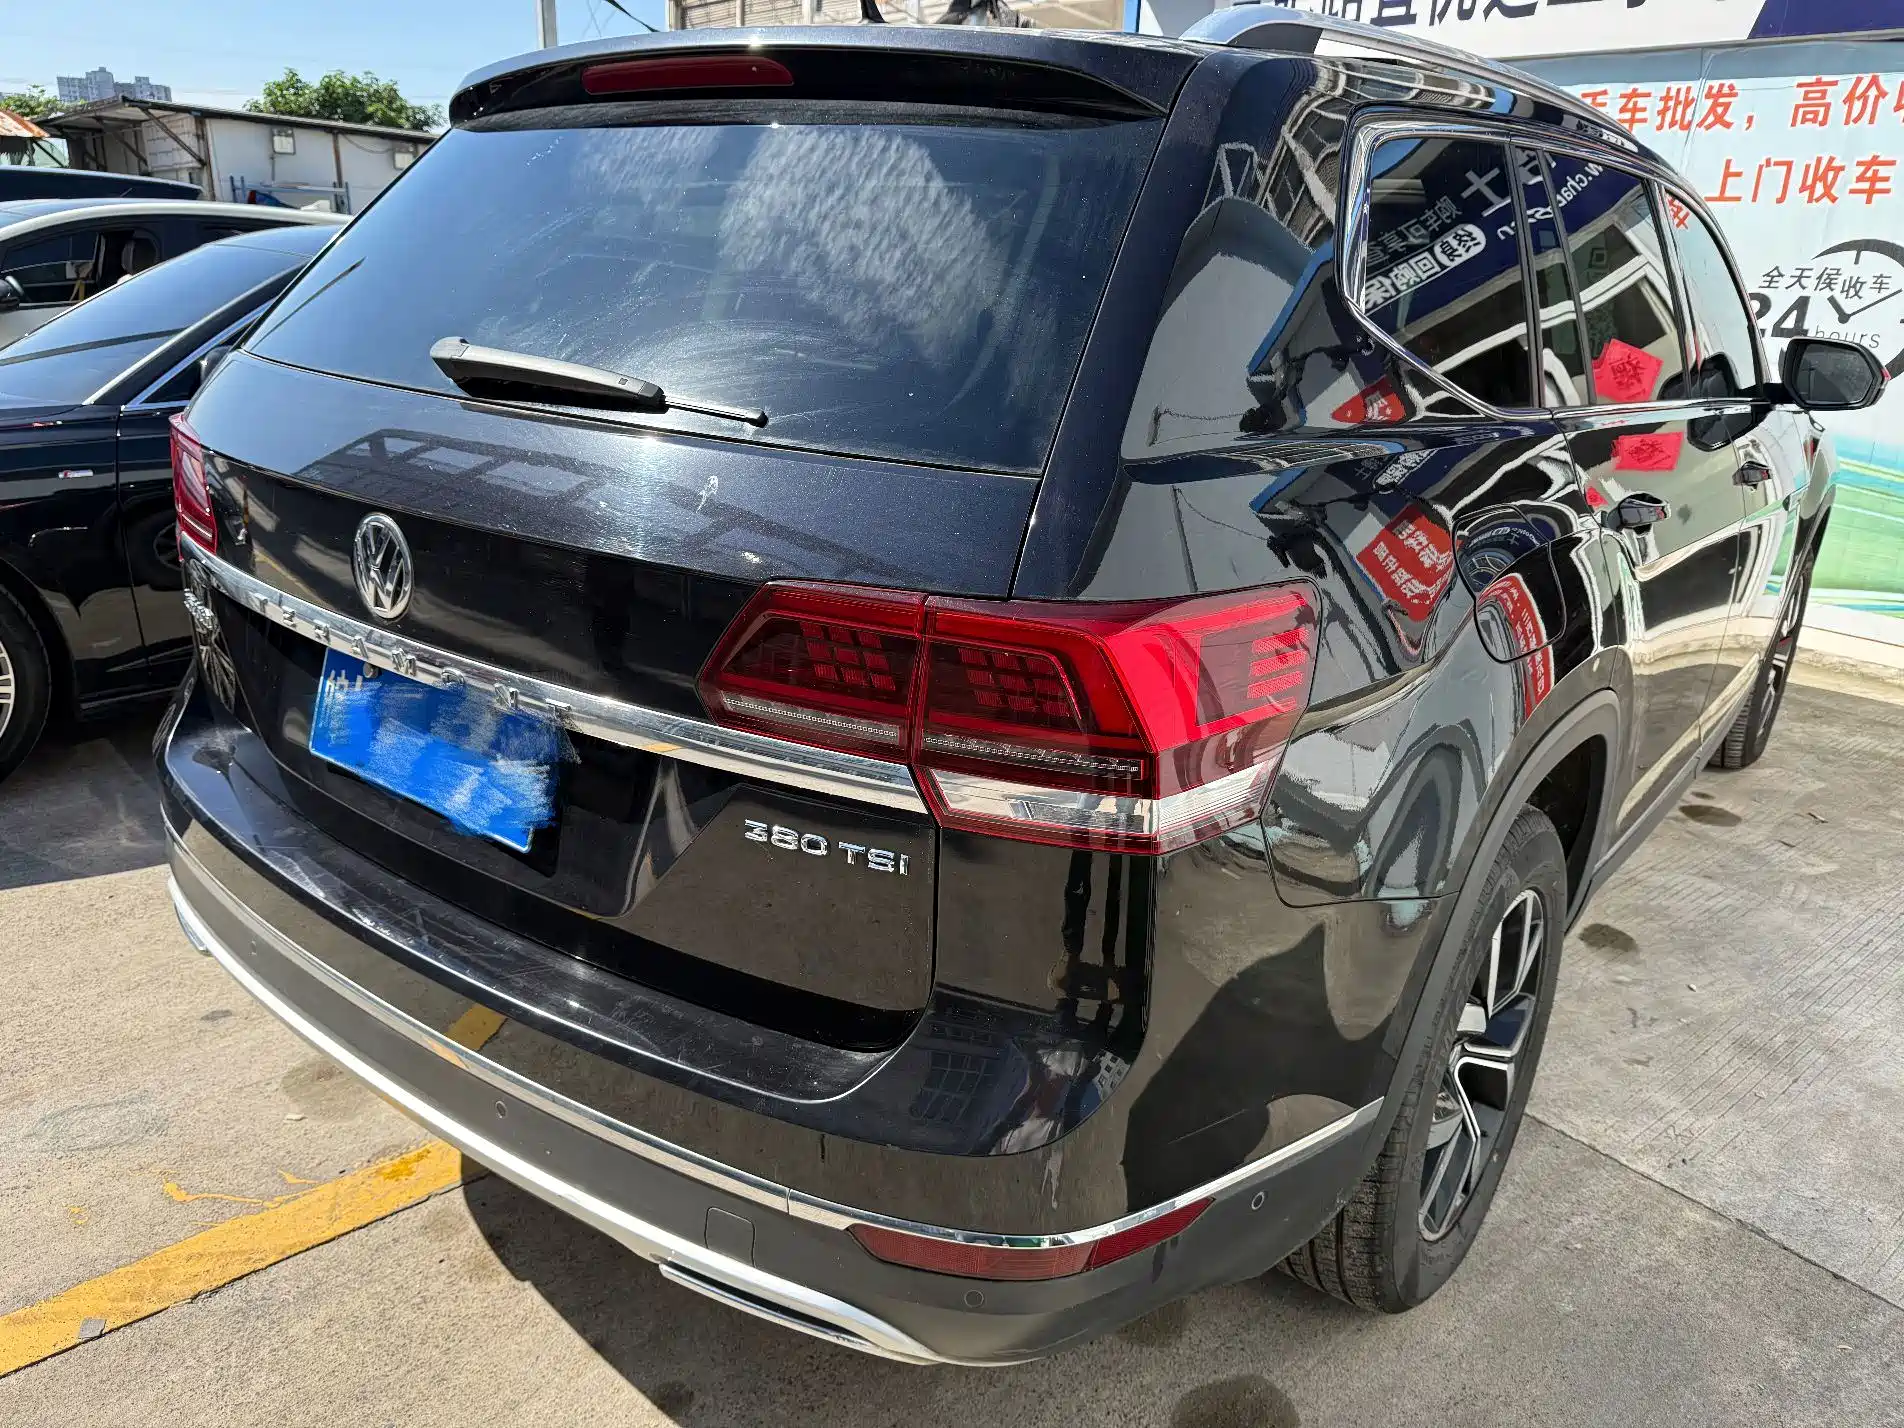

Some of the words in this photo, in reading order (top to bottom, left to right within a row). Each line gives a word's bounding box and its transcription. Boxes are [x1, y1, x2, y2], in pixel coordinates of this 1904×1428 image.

[1581, 73, 1904, 132] 手车批发，高价
[1704, 154, 1897, 205] 上门收车
[743, 818, 831, 857] 380
[838, 841, 910, 876] TSI
